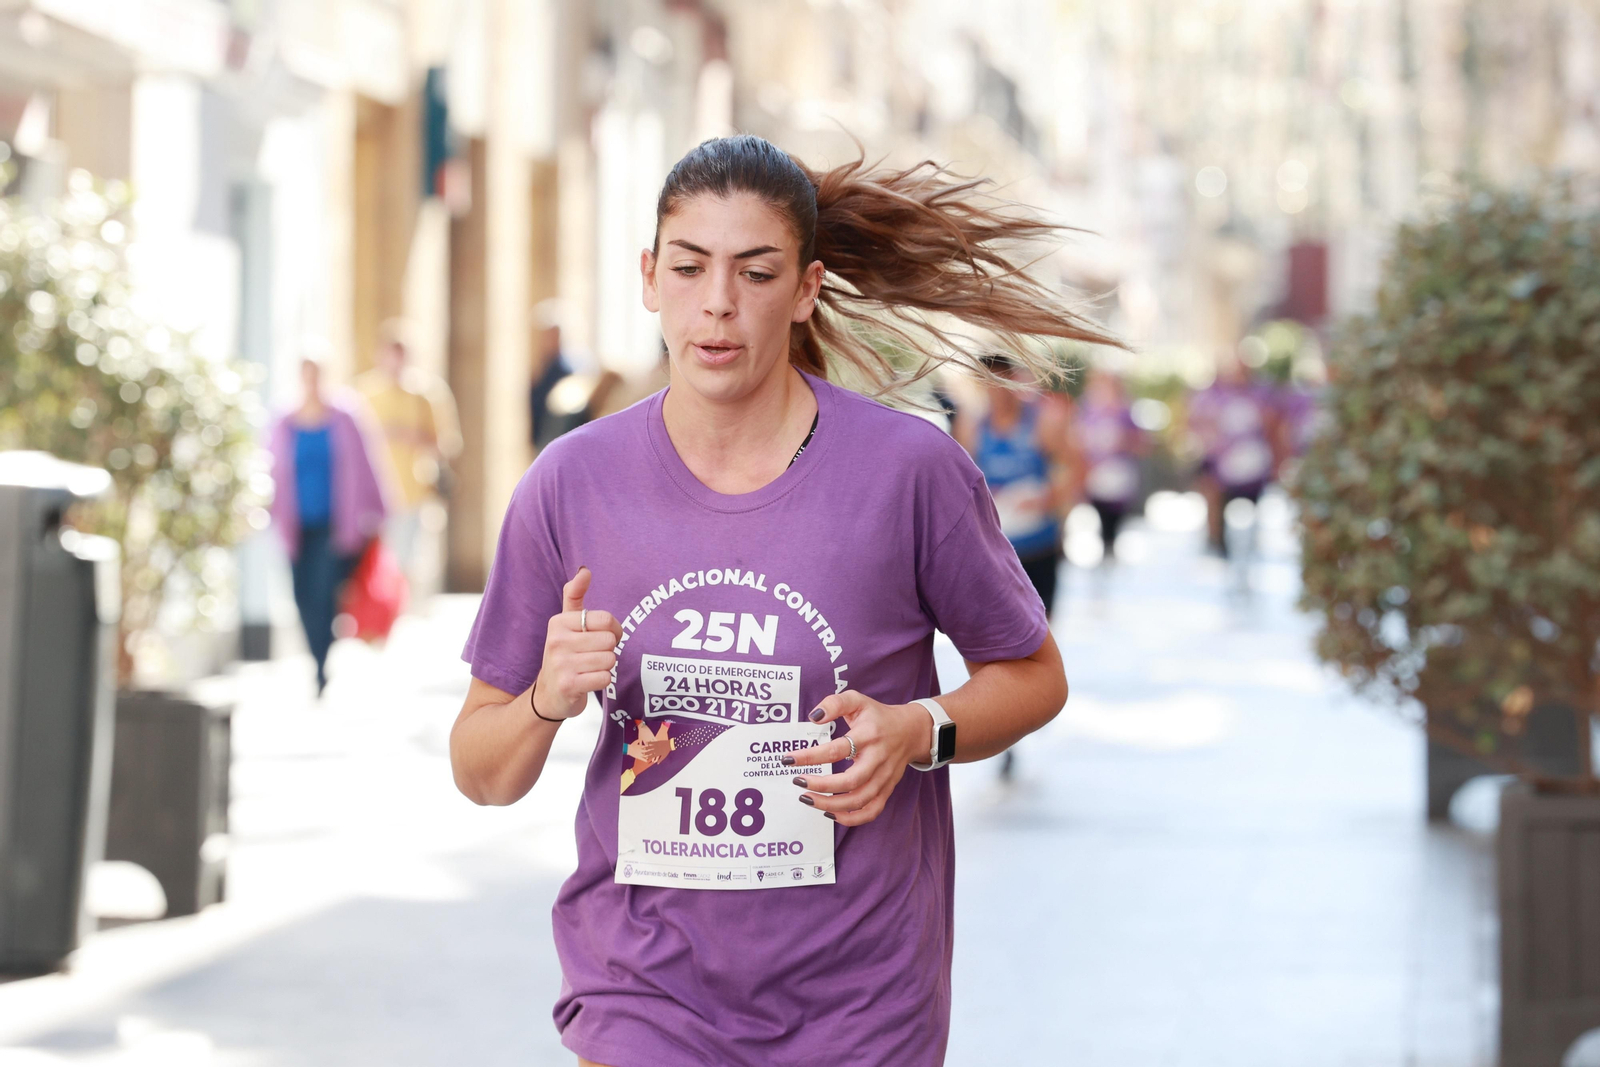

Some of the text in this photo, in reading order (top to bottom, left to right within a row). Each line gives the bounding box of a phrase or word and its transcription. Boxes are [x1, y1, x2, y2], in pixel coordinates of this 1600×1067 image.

[671, 608, 779, 656] 25N
[773, 582, 843, 663] CONTRA
[833, 664, 849, 695] LA
[646, 660, 794, 681] SERVICIO DE EMERGENCIAS
[663, 675, 772, 701] 24 HORAS
[650, 696, 788, 723] 900 21 21 30
[749, 739, 820, 754] CARRERA
[746, 755, 762, 763] POR
[743, 770, 775, 778] CONTRA
[790, 767, 823, 775] MUJERES
[675, 787, 766, 837] 188
[642, 839, 804, 859] TOLERANCIA CERO
